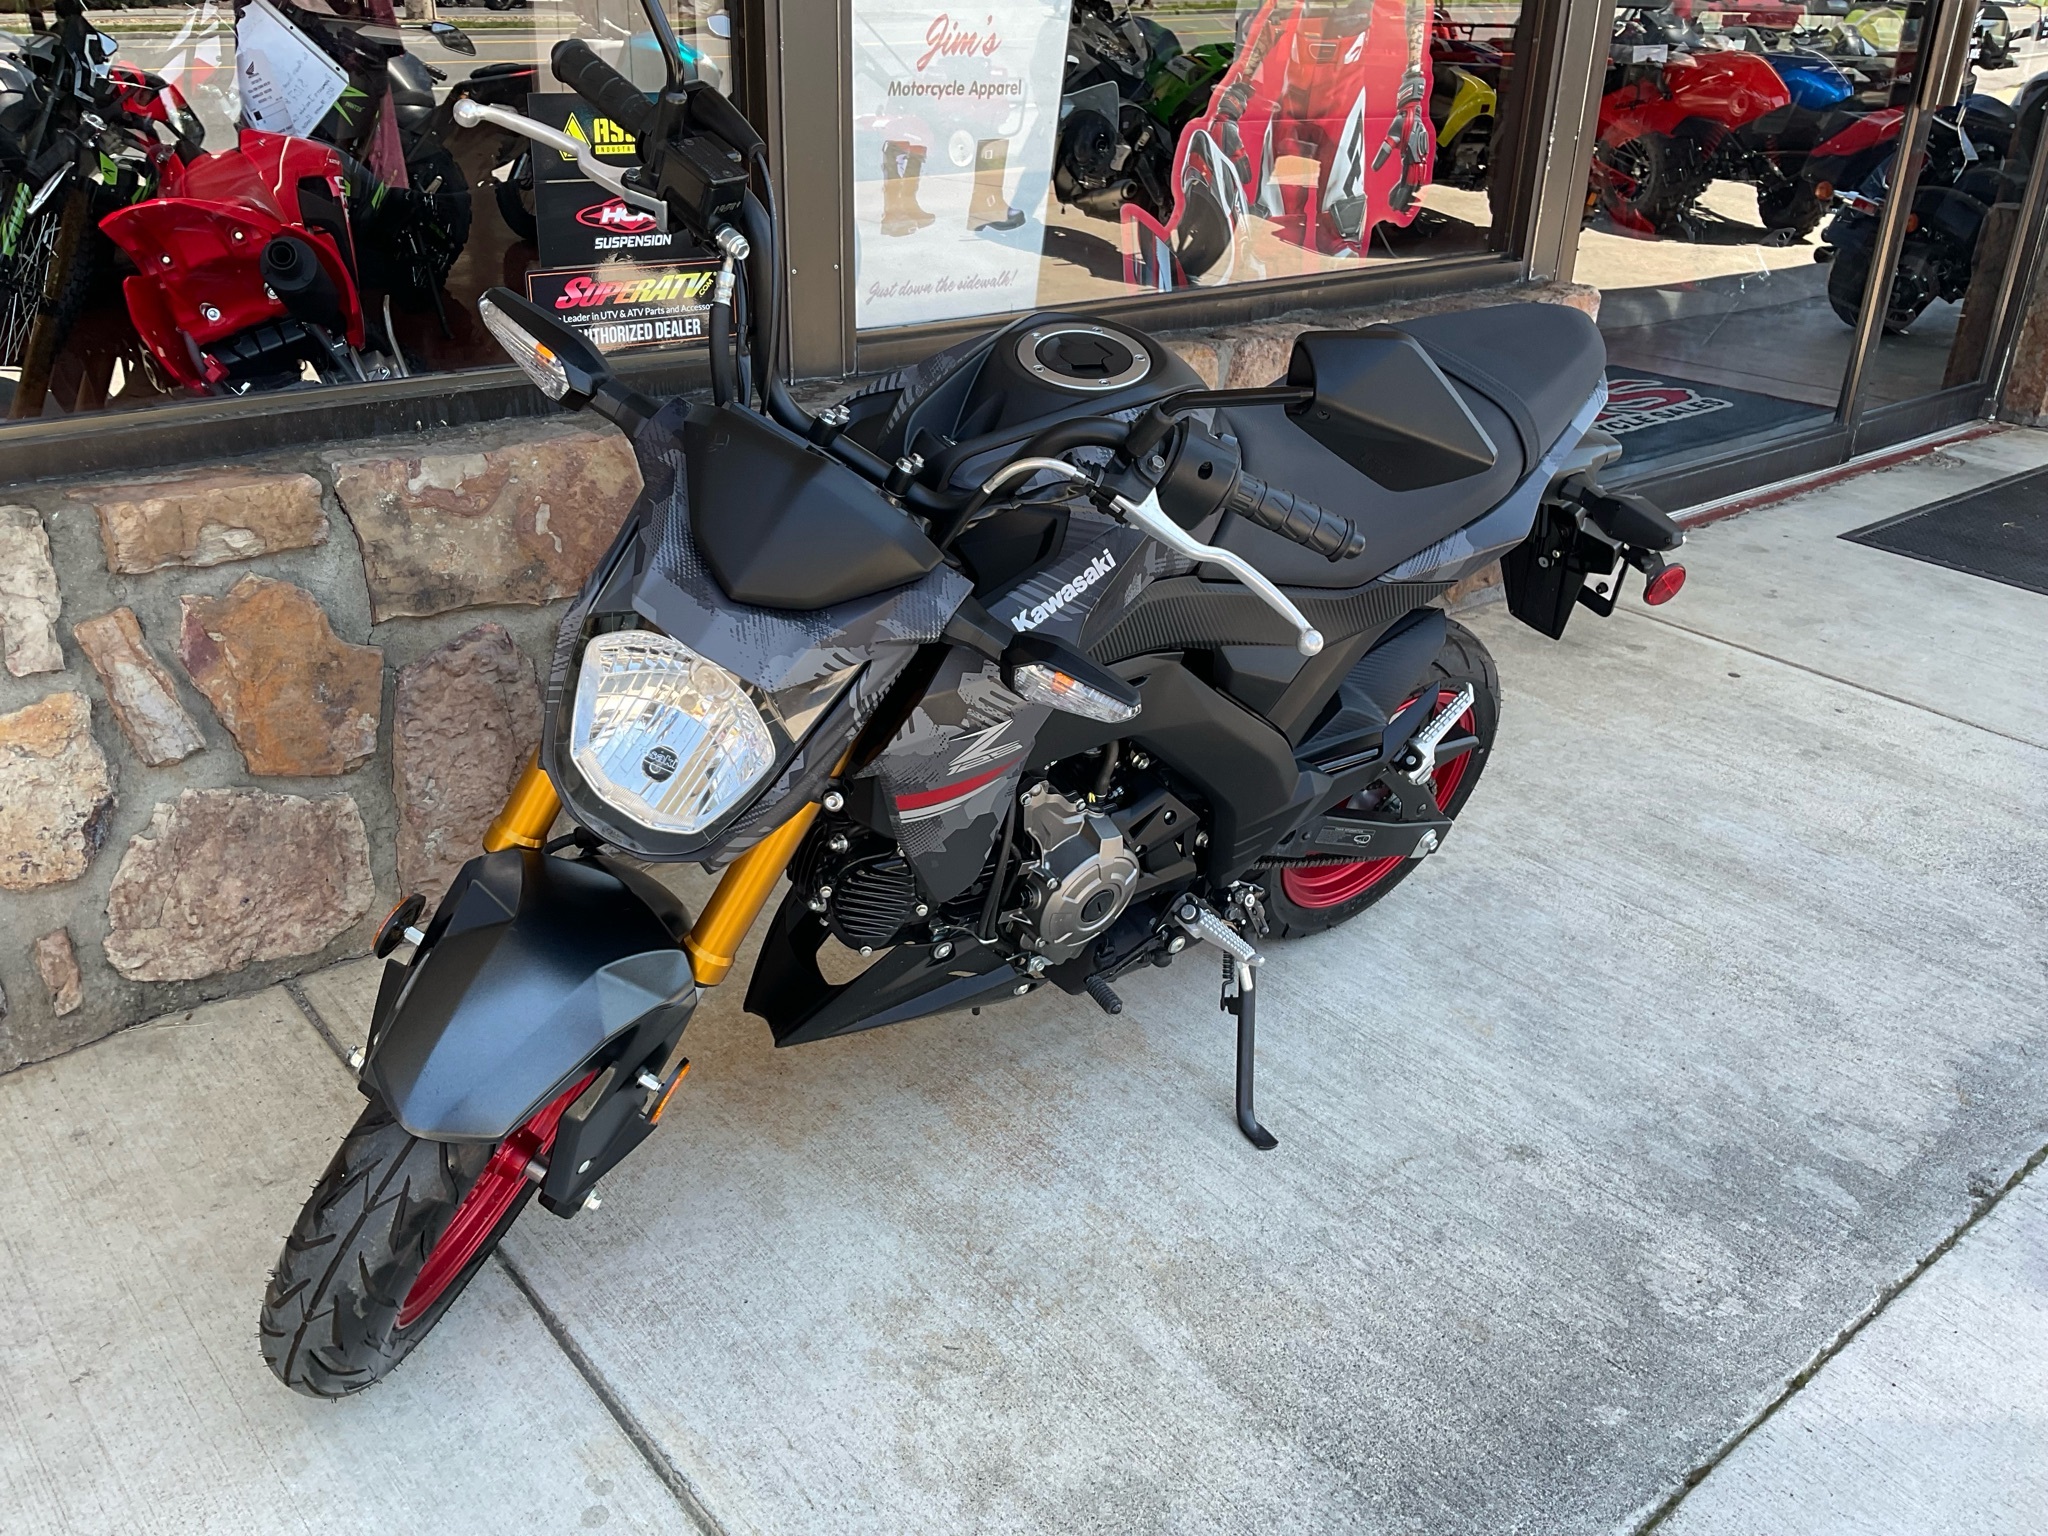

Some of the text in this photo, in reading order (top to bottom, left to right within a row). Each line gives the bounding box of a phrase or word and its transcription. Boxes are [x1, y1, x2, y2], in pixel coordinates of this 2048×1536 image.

[916, 13, 1002, 72] Jim's
[888, 80, 1022, 99] Motorcycle Apparel
[594, 234, 672, 249] SUSPENSION
[866, 269, 1018, 305] Just down the sidewalk!
[563, 313, 590, 323] Leader
[592, 312, 599, 321] in
[600, 310, 618, 320] UTV
[620, 310, 627, 318] &
[627, 308, 644, 317] ATV
[645, 306, 665, 316] Parts
[666, 305, 679, 314] and
[655, 318, 701, 340] DEALER
[1650, 398, 1725, 419] SALES
[1010, 548, 1117, 633] Kawasaki
